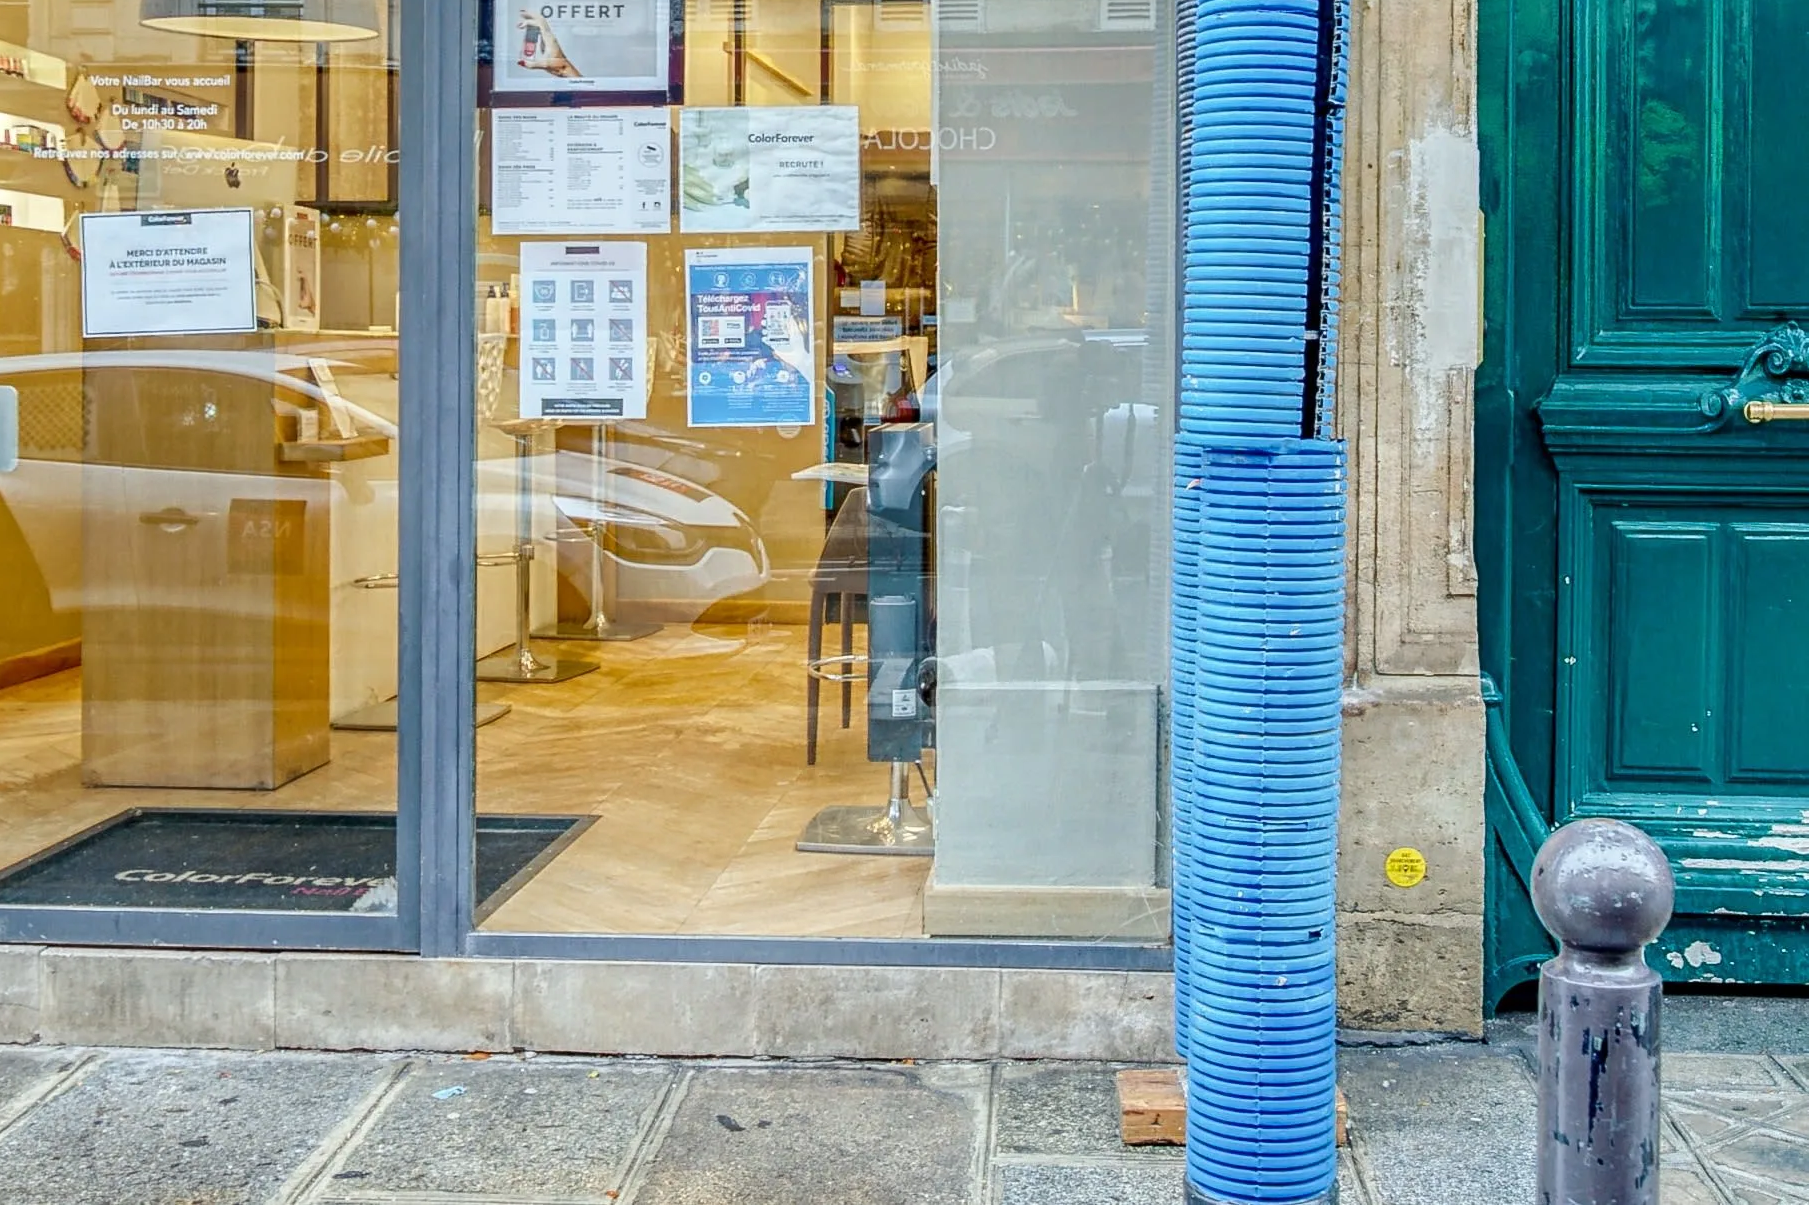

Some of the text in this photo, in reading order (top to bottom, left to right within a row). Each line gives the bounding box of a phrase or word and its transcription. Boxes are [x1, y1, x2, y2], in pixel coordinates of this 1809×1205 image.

[541, 5, 625, 19] OFFERT
[91, 75, 231, 87] Votre NailBar vous accueil
[112, 104, 218, 116] Du lundi au Samedi
[122, 119, 208, 131] De 10h30 à 20h
[748, 133, 815, 144] ColorForever
[33, 148, 88, 161] Retrouvez
[90, 150, 111, 161] nos
[112, 148, 159, 161] adresses
[161, 150, 178, 161] sur
[127, 247, 208, 258] MERCI D'ATTENDRE
[172, 258, 185, 267] DU
[186, 257, 227, 267] MAGASIN
[697, 304, 761, 314] TousAntiCovid
[115, 869, 391, 887] ColorForeve
